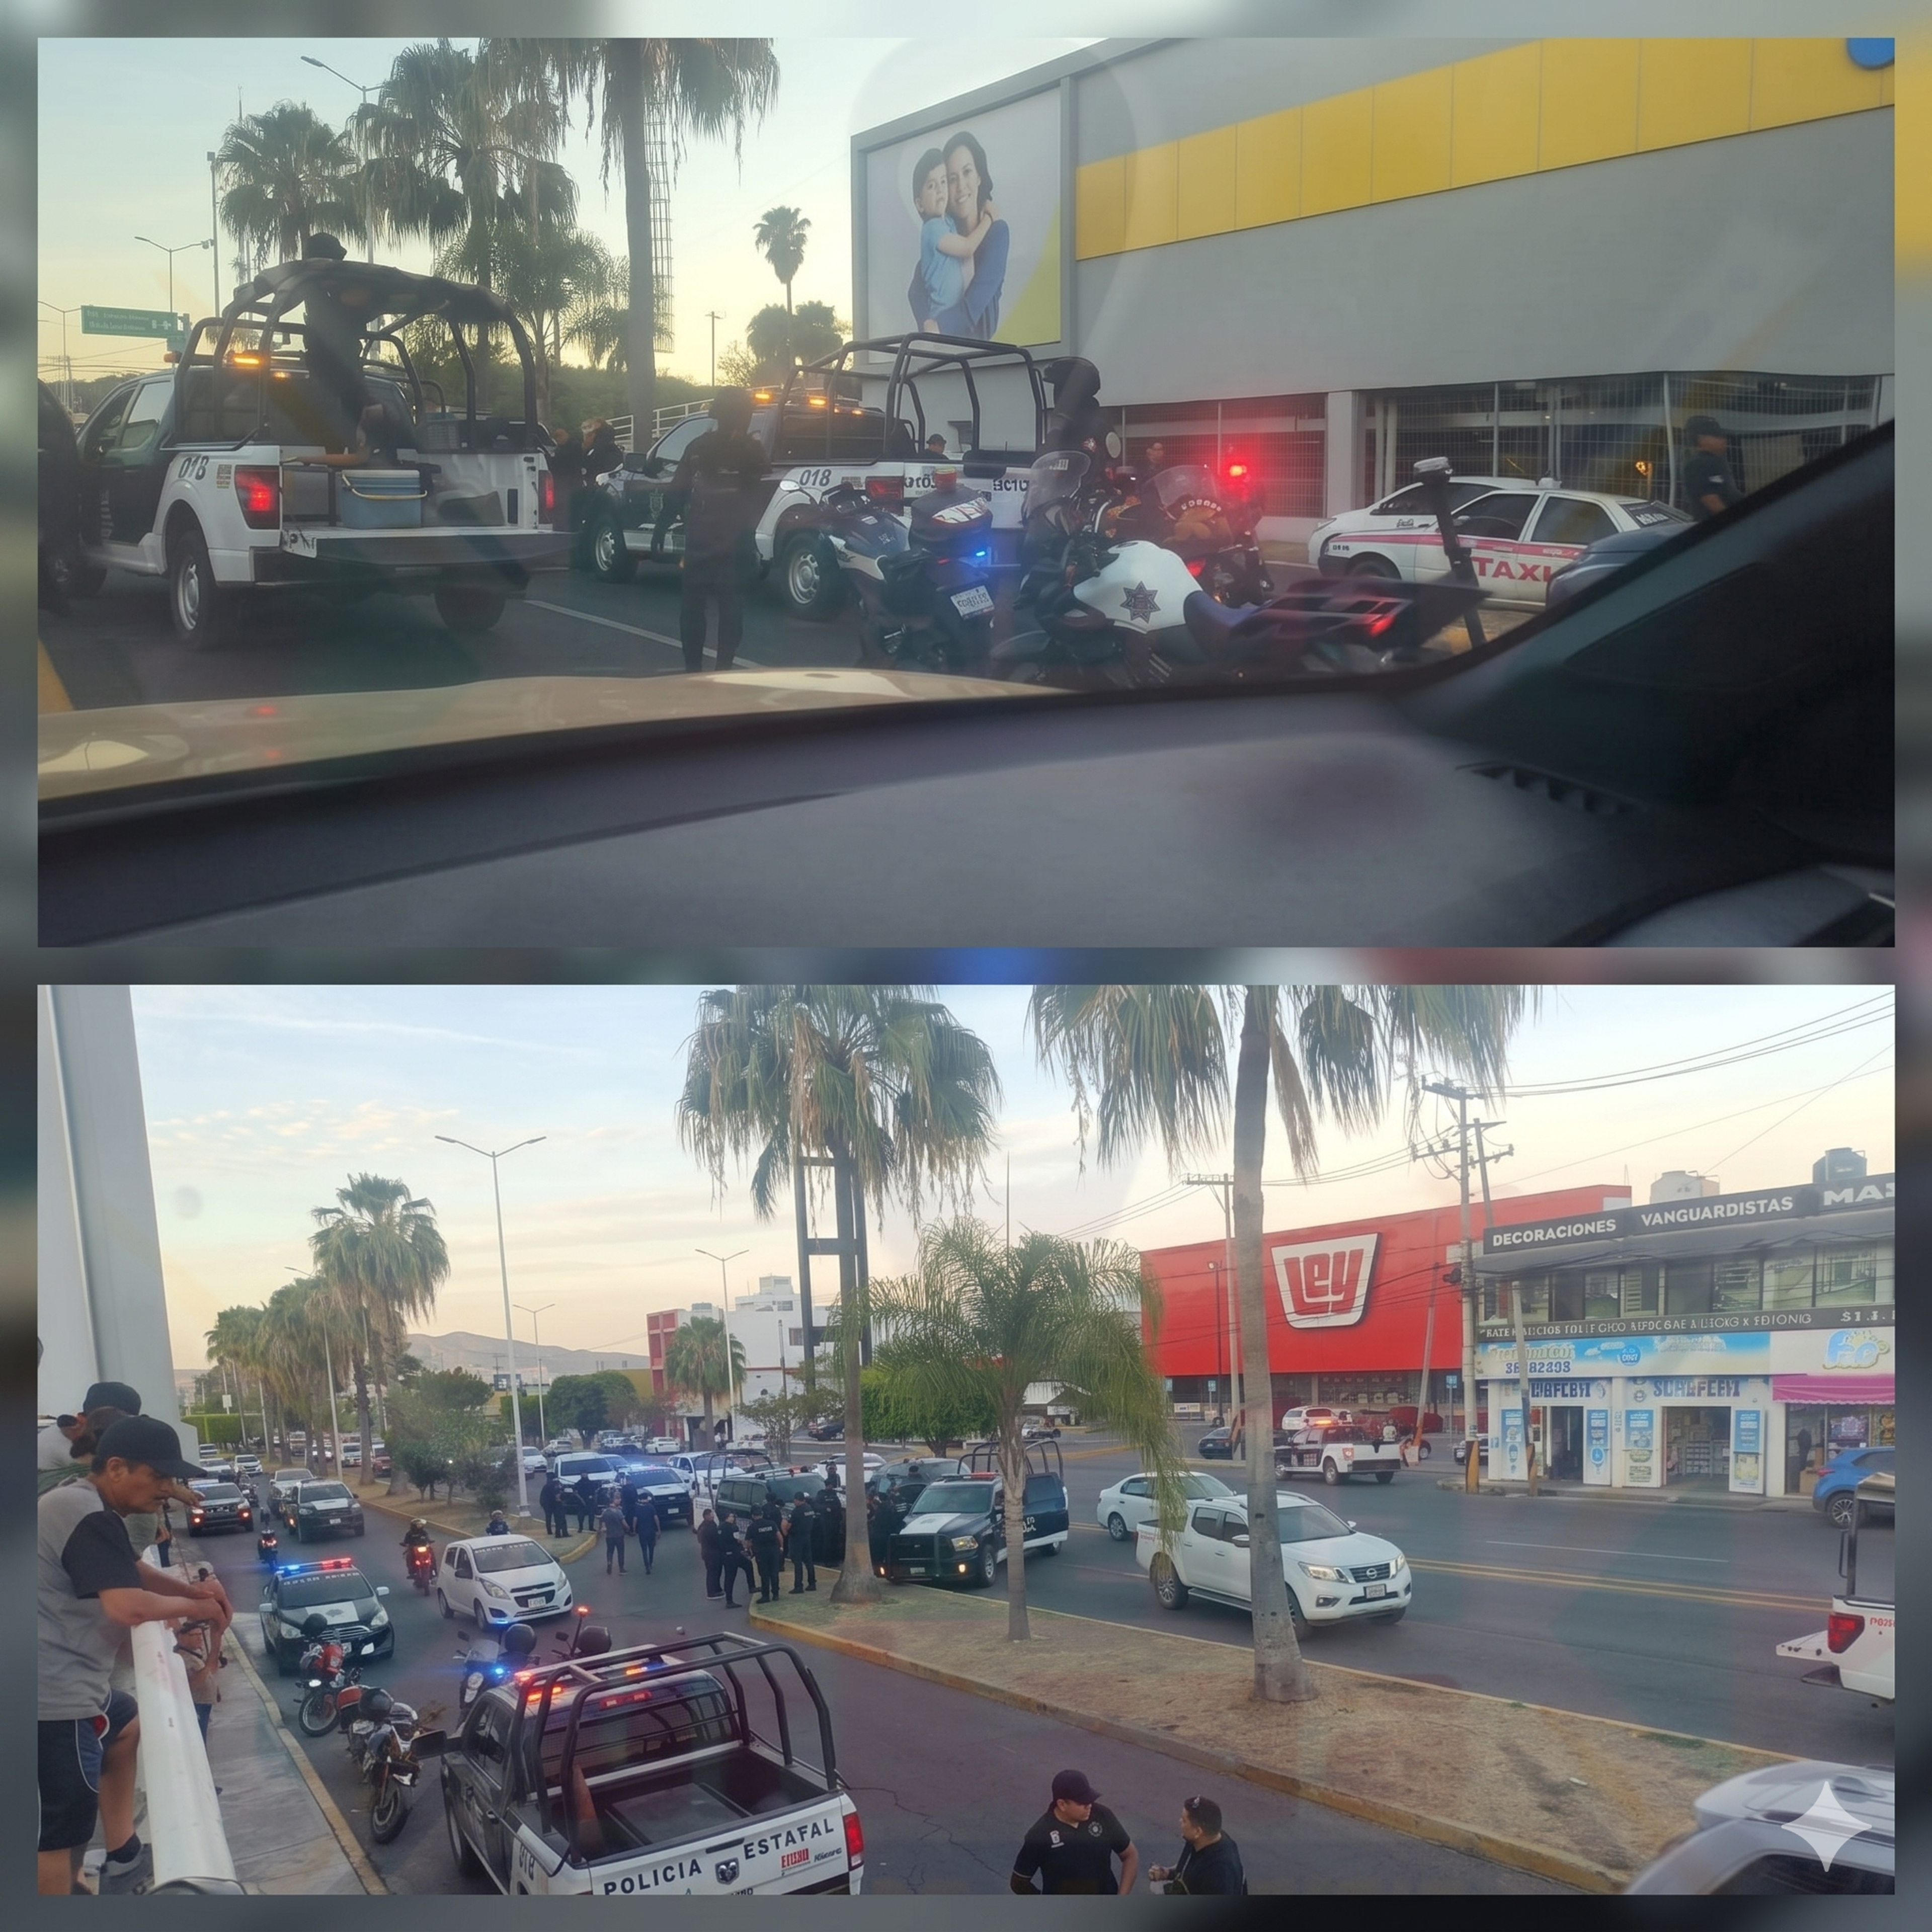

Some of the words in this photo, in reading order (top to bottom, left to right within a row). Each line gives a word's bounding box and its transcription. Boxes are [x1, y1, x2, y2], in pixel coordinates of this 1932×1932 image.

[178, 455, 210, 480] 018
[799, 468, 832, 487] 018
[1471, 556, 1547, 583] TAXI
[1492, 1219, 1617, 1246] DECORACIONES
[1641, 1196, 1793, 1227] VANGUARDISTAS
[604, 1859, 702, 1895] POLICIA
